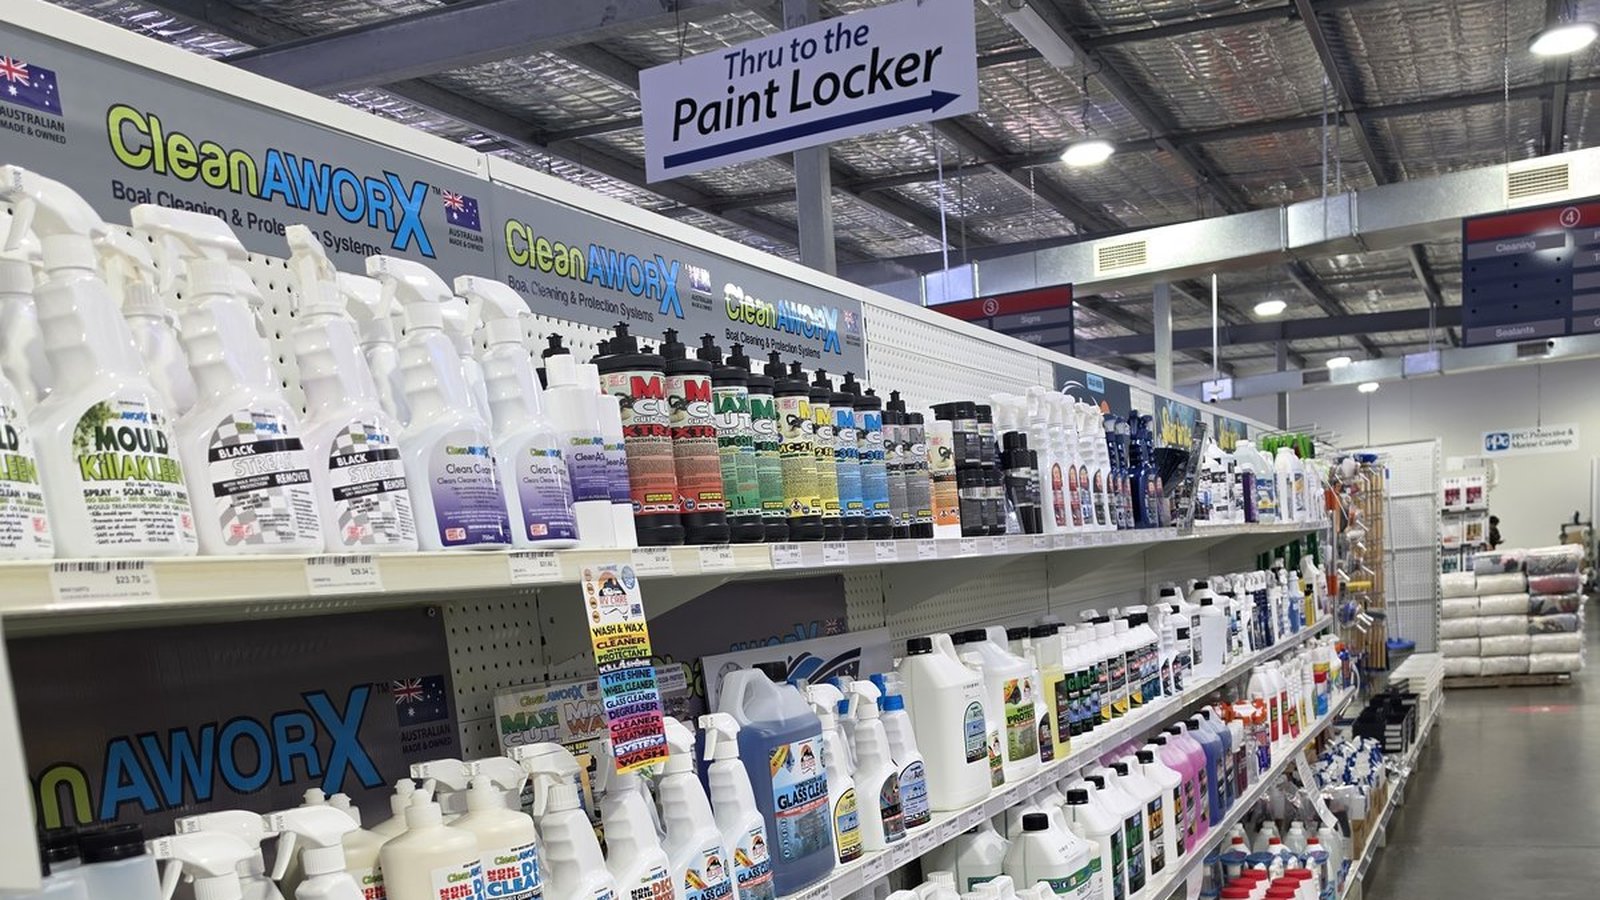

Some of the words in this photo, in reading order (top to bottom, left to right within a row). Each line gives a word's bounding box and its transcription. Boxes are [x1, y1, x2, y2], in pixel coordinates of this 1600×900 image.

[724, 48, 783, 80] Thru
[790, 38, 817, 62] to
[824, 22, 869, 54] the
[672, 79, 779, 142] Paint
[789, 46, 943, 113] Locker
[0, 106, 65, 132] AUSTRALIAN
[0, 120, 27, 135] MADE
[35, 131, 66, 145] OWNED
[106, 102, 437, 259] CleanAWORX
[231, 208, 243, 227] &
[1495, 240, 1536, 252] Cleaning
[504, 218, 684, 320] CleanAWORX
[95, 426, 168, 455] MOULD
[218, 444, 256, 459] BLACK
[336, 453, 368, 466] BLACK
[446, 463, 473, 474] Clears
[275, 471, 309, 485] REMOVER
[83, 488, 111, 498] SPRAY
[122, 488, 145, 497] SOAK
[592, 625, 617, 637] WASH
[617, 624, 623, 633] &
[624, 623, 645, 632] WAX
[596, 637, 646, 650] CLEANER
[597, 649, 648, 662] PROTECTANT
[603, 671, 626, 685] TYRE
[626, 668, 651, 680] SHINE
[604, 685, 625, 697] WHEEL
[625, 679, 655, 691] CLEANER
[606, 697, 627, 709] GLASS
[627, 693, 657, 704] CLEANER
[608, 702, 658, 720] DEGREASER
[611, 715, 661, 732] CLEANER
[401, 725, 451, 744] AUSTRALIAN
[612, 726, 662, 745] TREATMENT
[402, 740, 423, 753] MADE
[430, 736, 452, 749] OWNED
[618, 749, 665, 767] WASH
[777, 787, 808, 810] GLASS
[487, 866, 520, 877] NON-
